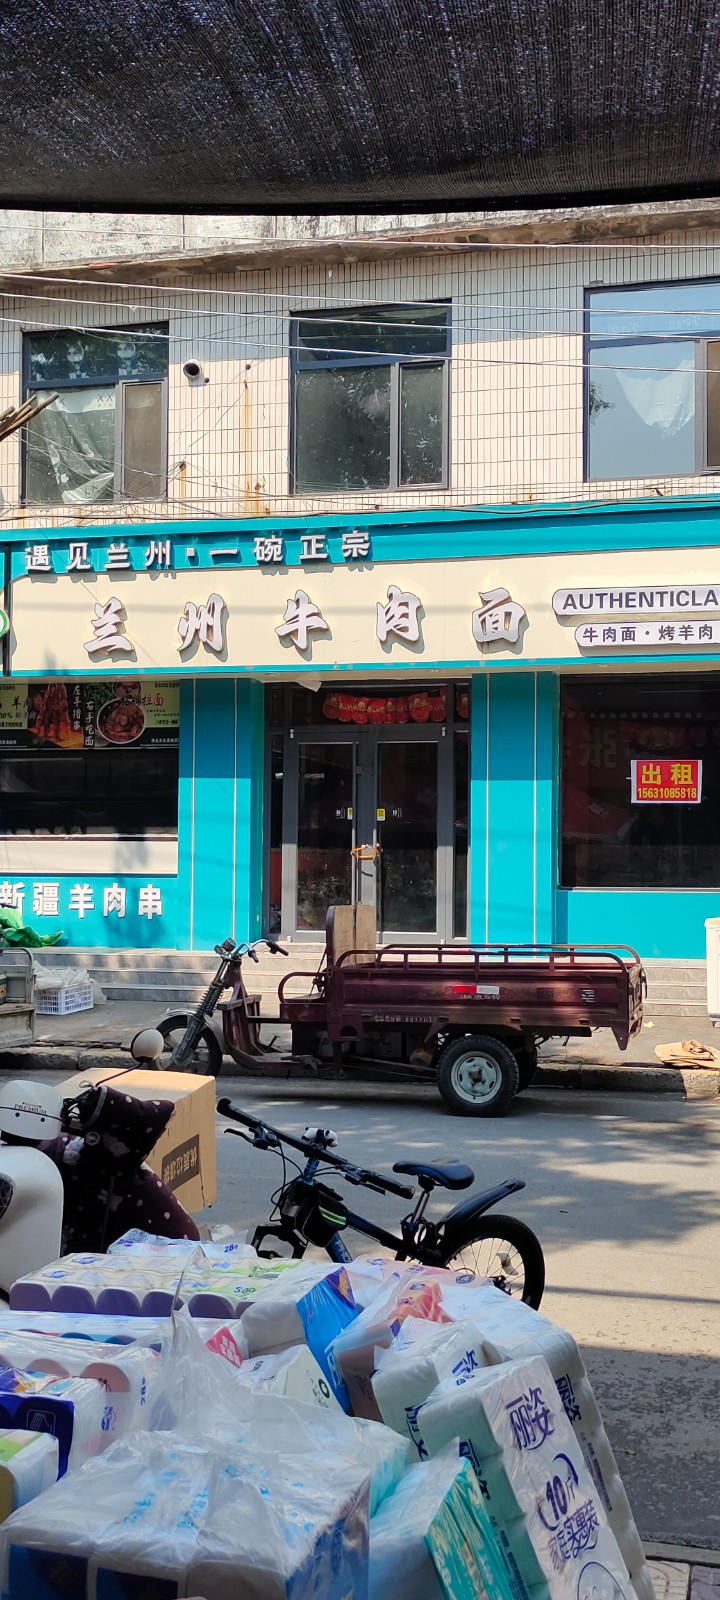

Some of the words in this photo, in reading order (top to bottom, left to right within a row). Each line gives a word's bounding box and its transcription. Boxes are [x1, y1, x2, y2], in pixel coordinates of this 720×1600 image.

[562, 589, 719, 610] AUTHENTICLA
[83, 586, 525, 656] 兰州牛肉面
[582, 624, 713, 643] 牛肉面·烤羊肉
[640, 763, 693, 786] 出租
[637, 787, 697, 800] 15631085818
[0, 881, 163, 919] 新疆羊肉串
[505, 1387, 555, 1451] 丽姿
